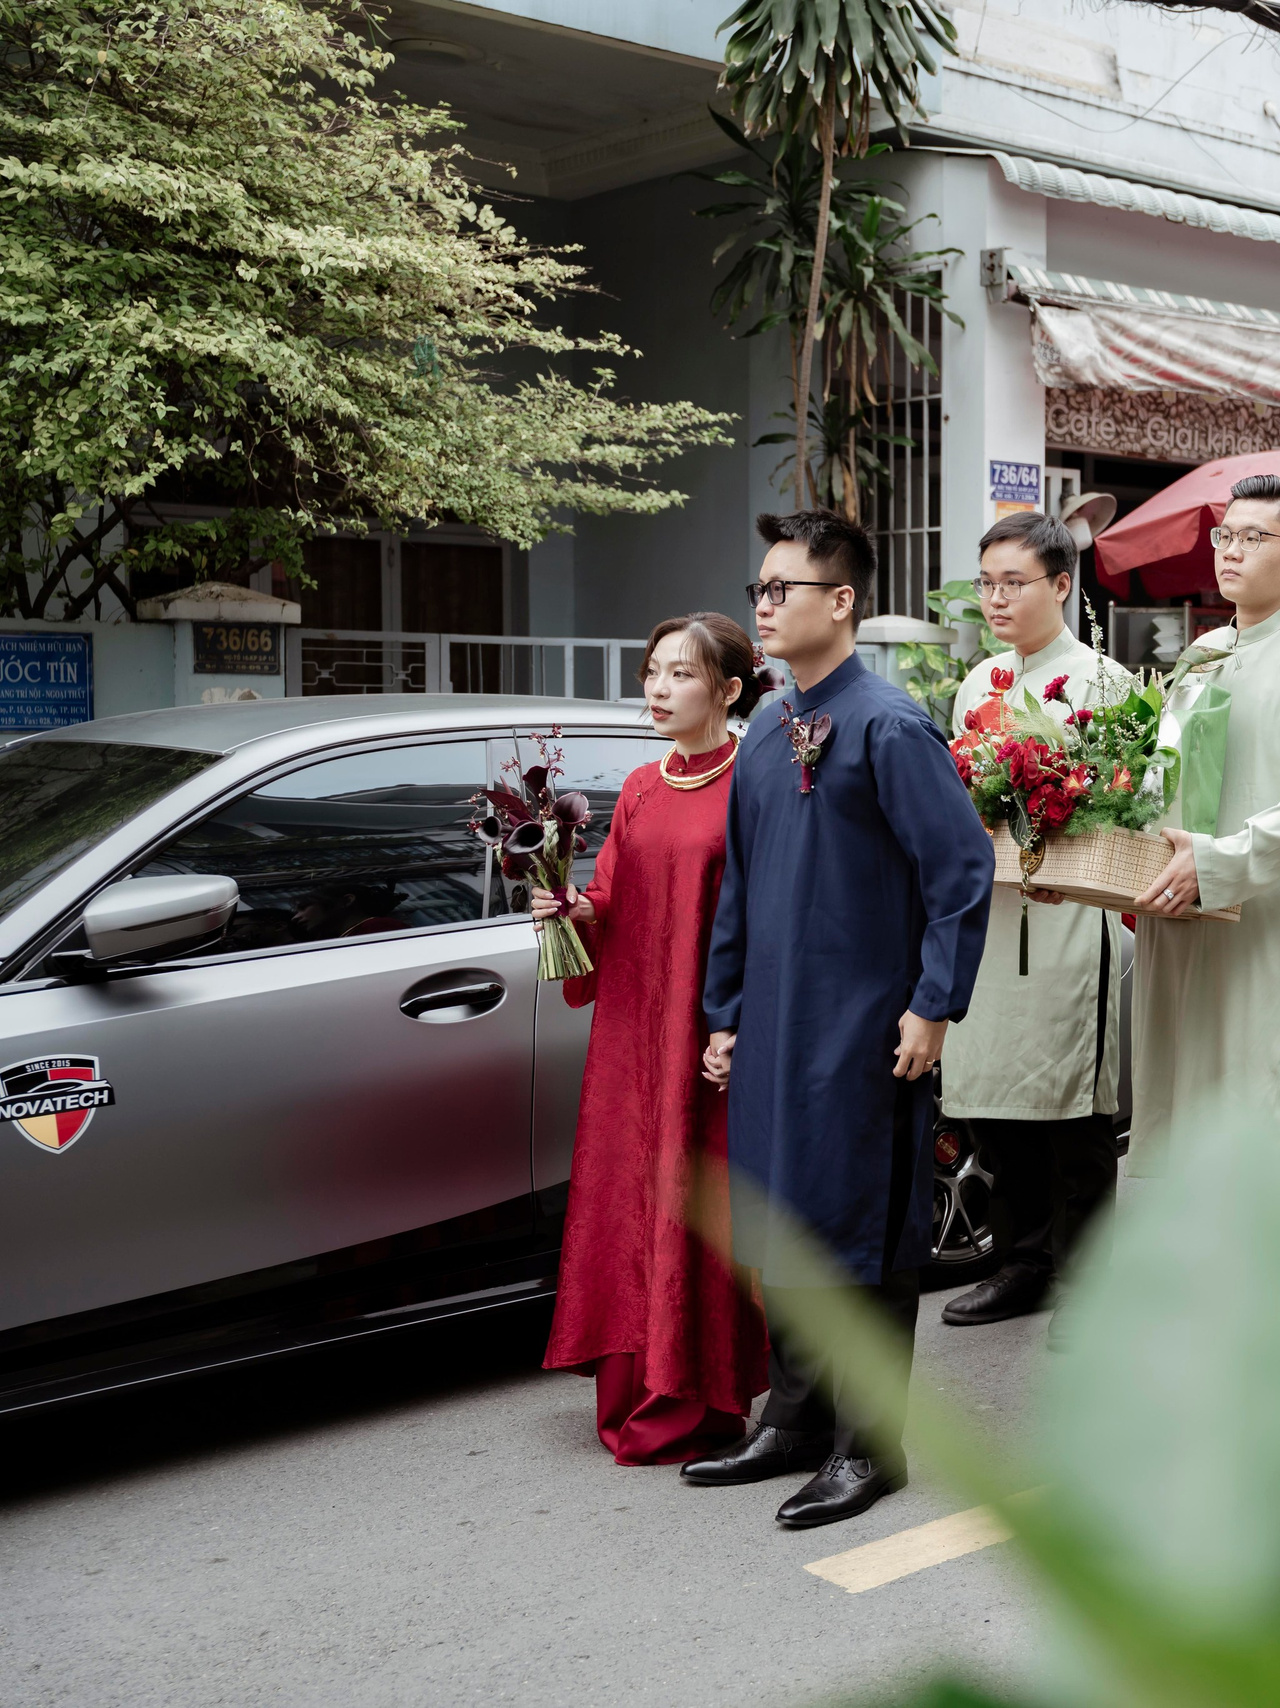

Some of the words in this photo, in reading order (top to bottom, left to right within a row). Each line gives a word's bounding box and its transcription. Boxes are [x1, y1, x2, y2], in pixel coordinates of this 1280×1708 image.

[993, 464, 1038, 487] 736/64
[202, 627, 272, 652] 736/66
[18, 640, 46, 653] NHIỆM
[66, 642, 83, 654] HẠN
[46, 656, 78, 684] TÍN
[16, 687, 28, 699] TRÍ
[28, 687, 41, 700] NỘI
[45, 689, 67, 700] NGOẠI
[67, 686, 86, 699] THẤT
[70, 706, 86, 715] HCM
[24, 717, 38, 725] Fax:
[25, 1061, 50, 1072] SINCE
[51, 1059, 71, 1068] 2015
